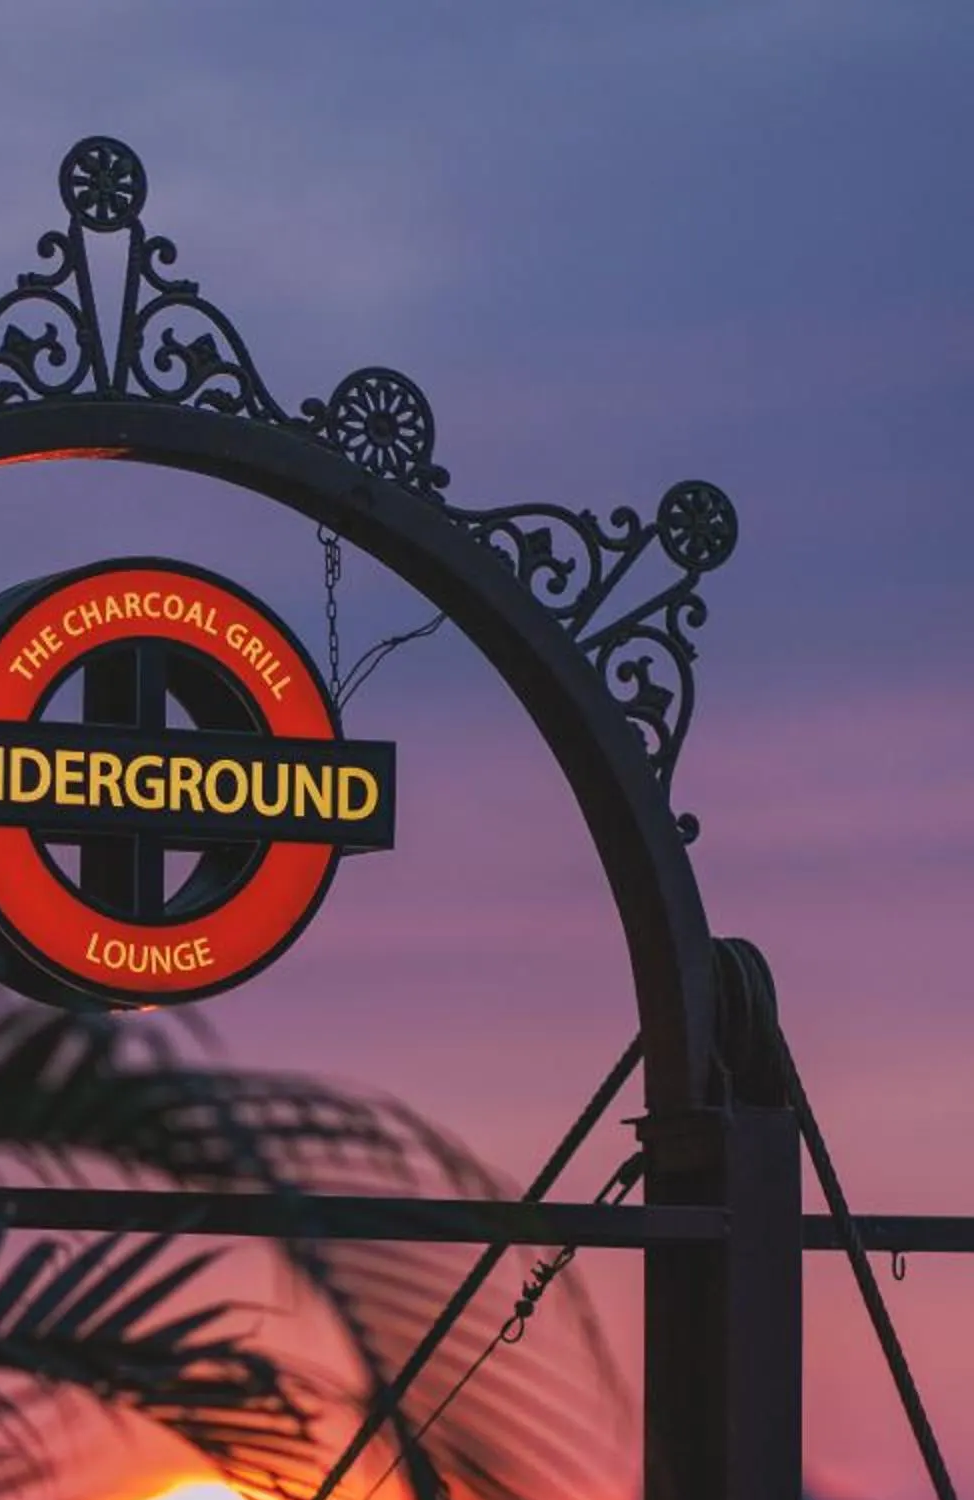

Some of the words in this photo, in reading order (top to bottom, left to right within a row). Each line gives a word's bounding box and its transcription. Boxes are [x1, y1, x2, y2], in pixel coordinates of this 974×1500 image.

[8, 626, 63, 681] THE
[63, 591, 218, 637] CHARCOAL
[225, 623, 293, 701] GRILL
[85, 932, 215, 975] LOUNGE
